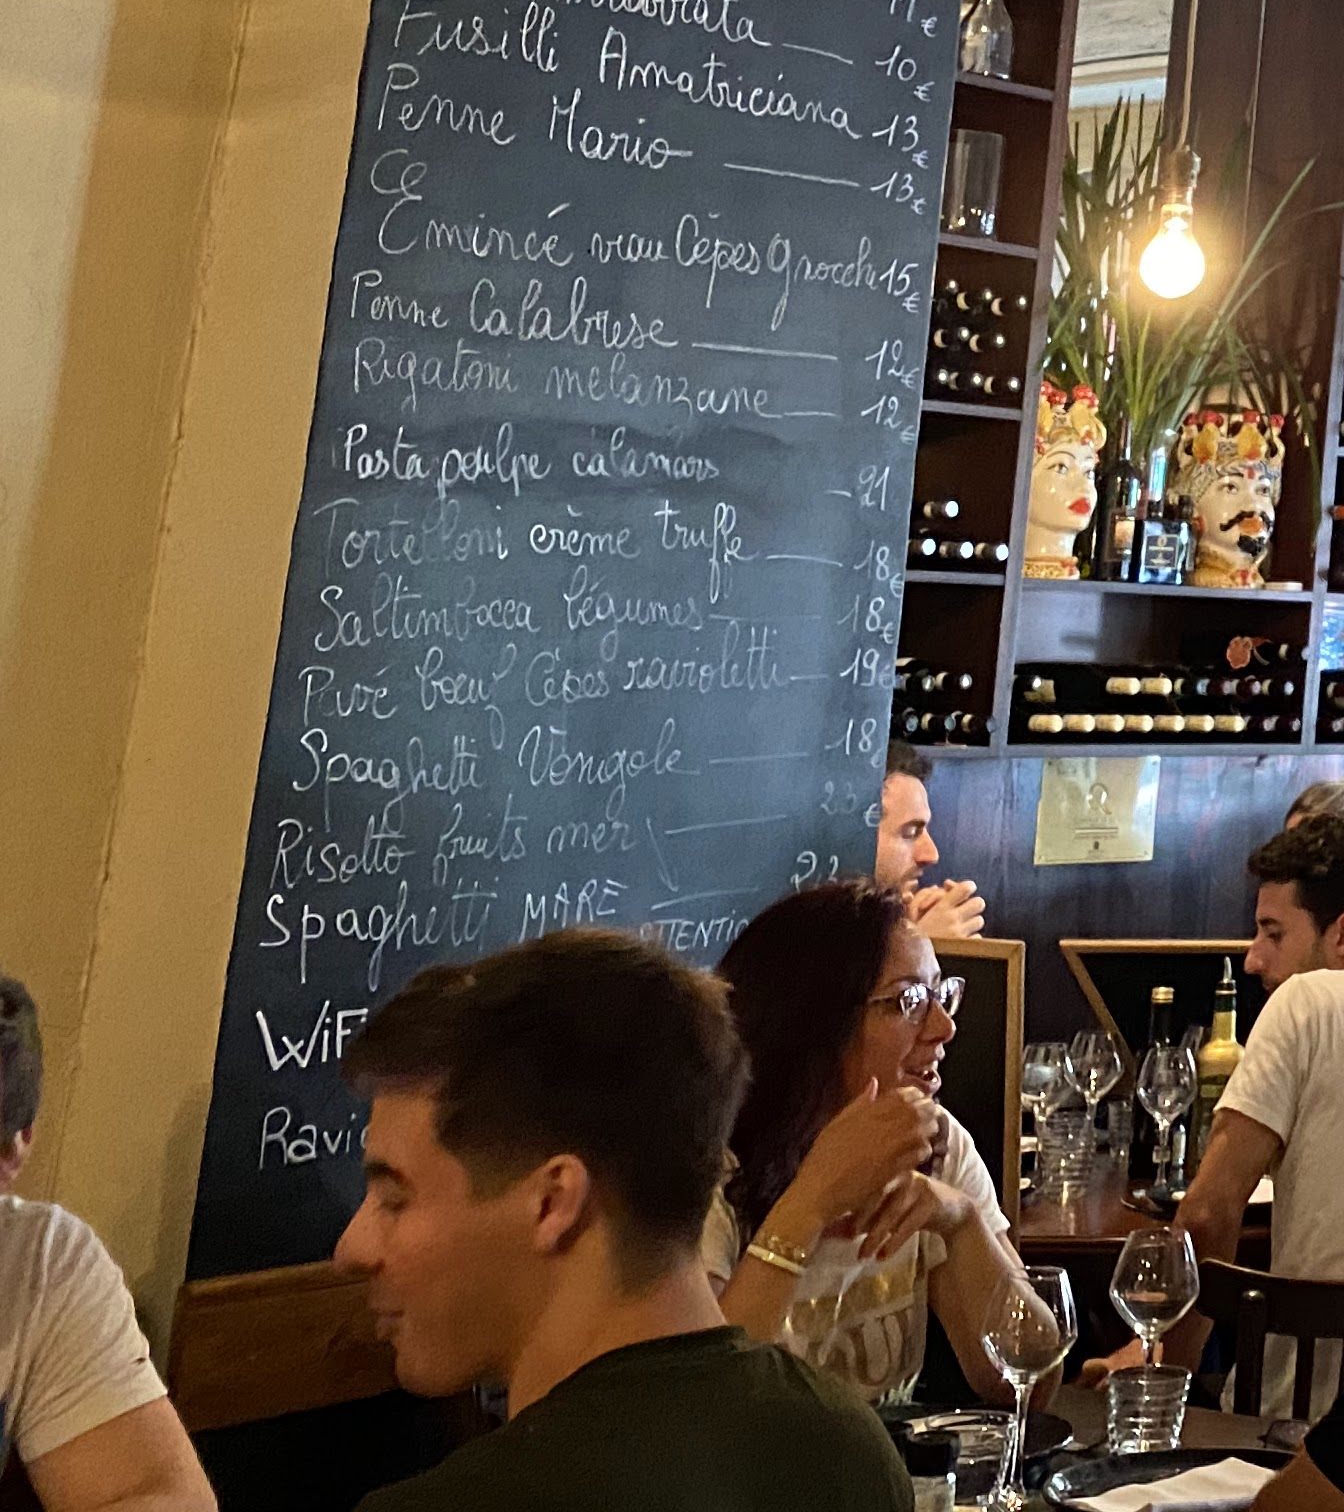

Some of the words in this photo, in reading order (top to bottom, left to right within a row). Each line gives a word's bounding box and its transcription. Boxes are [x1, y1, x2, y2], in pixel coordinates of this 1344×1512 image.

[378, 62, 516, 146] Penne
[550, 87, 693, 170] Mario
[599, 25, 863, 140] Amatriciana
[351, 268, 449, 329] Penne
[470, 275, 679, 350] Calabrese
[353, 337, 519, 413] Rigatoni
[343, 423, 431, 481] Pasta
[292, 727, 484, 836] Spaghetti
[270, 814, 416, 889] Risotto
[255, 999, 370, 1072] WiF
